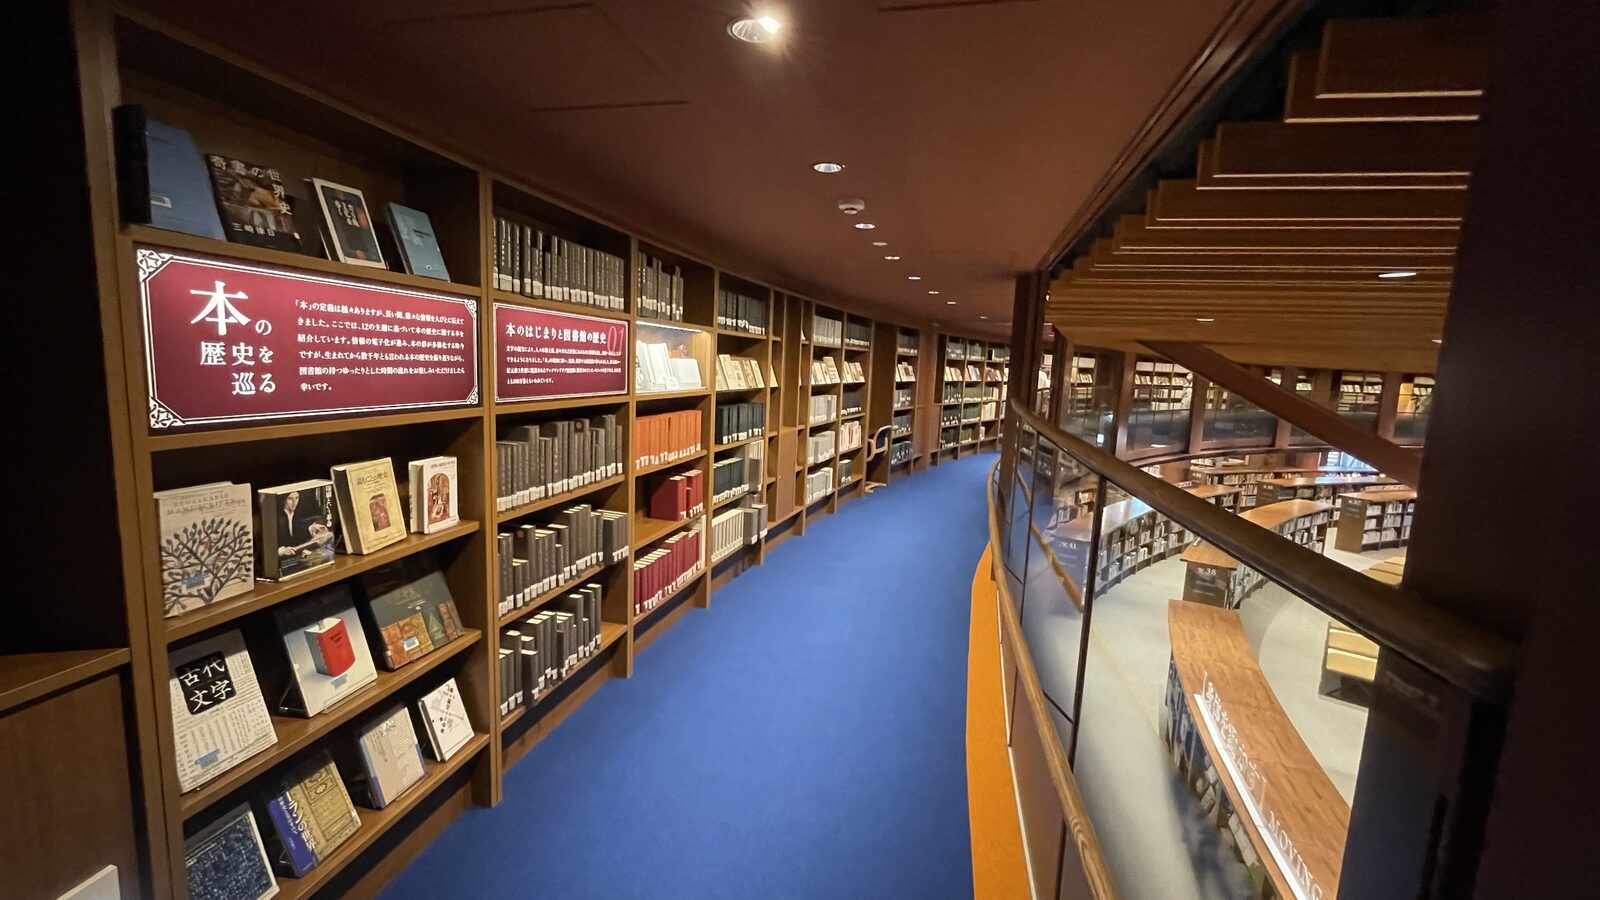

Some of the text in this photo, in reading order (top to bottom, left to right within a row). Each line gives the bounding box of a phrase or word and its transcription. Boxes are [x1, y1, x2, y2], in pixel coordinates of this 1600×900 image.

[189, 280, 273, 336] 本の
[505, 322, 607, 344] 本のはじまりと図書館の歴史
[607, 326, 624, 352] 01
[200, 341, 273, 366] 歴史を
[231, 372, 276, 395] 巡る
[300, 382, 332, 392] 幸いです。
[179, 660, 225, 686] 古代
[190, 680, 232, 712] 文字
